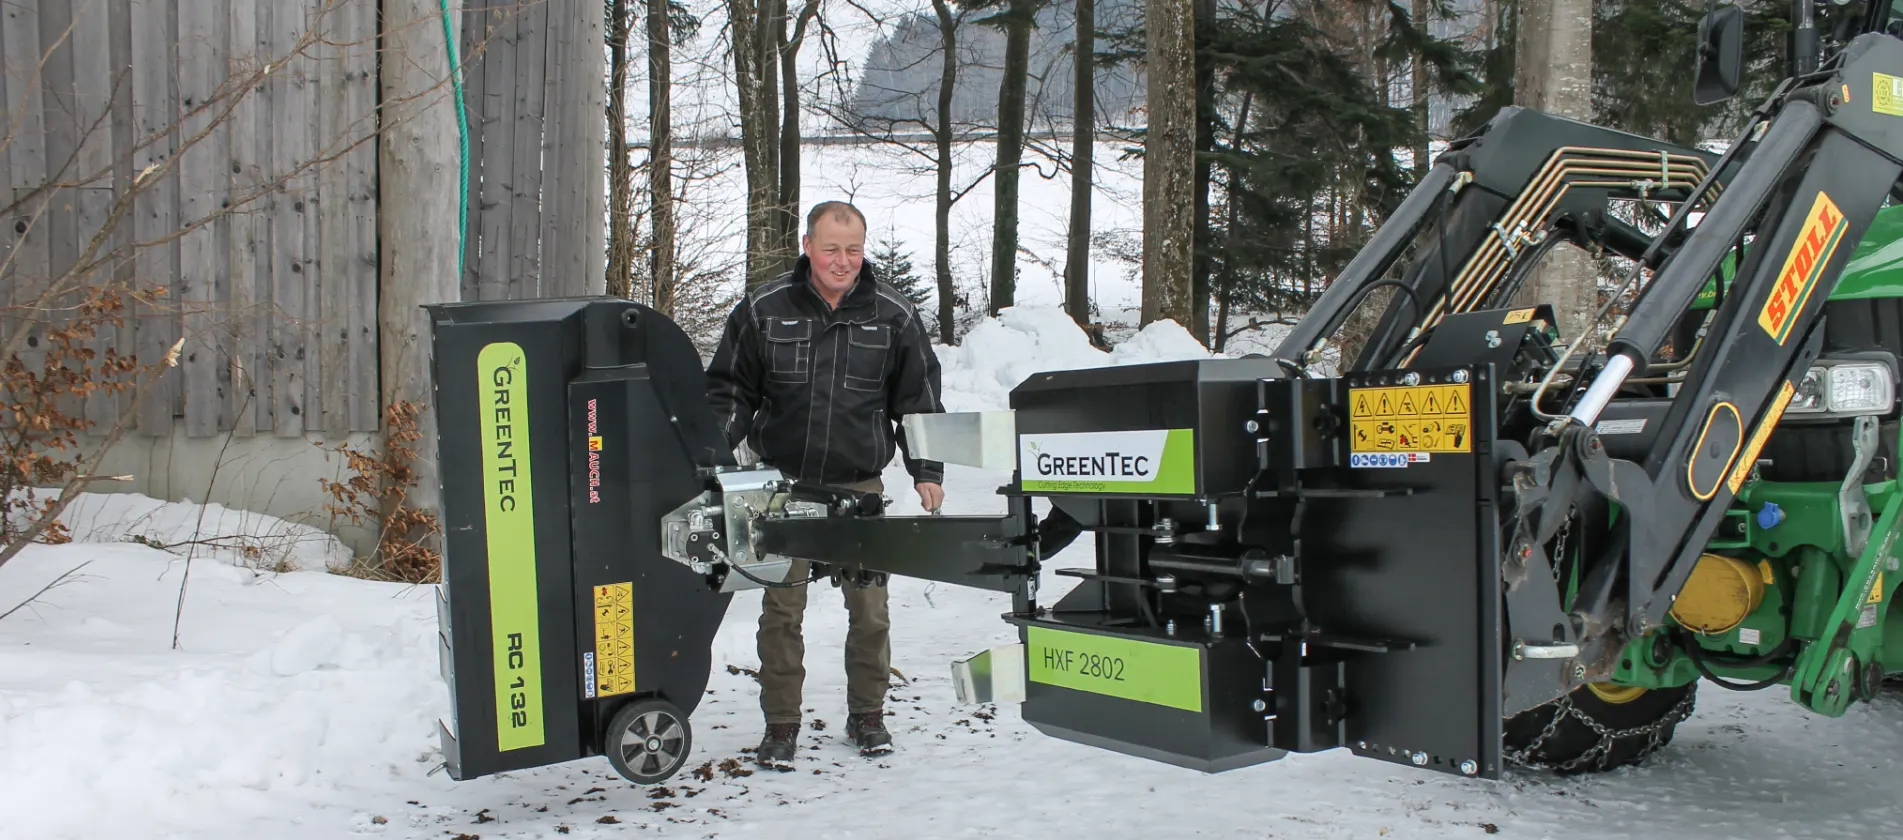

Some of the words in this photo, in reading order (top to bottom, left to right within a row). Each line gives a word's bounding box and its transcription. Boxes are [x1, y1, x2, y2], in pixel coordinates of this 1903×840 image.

[1767, 204, 1837, 332] STOLL
[493, 366, 517, 513] GREENTEC
[587, 398, 602, 504] www.MAUCH.at
[1037, 452, 1149, 476] GREENTEC
[1038, 480, 1057, 491] Cutting
[1058, 481, 1073, 491] Edge
[1073, 481, 1106, 492] Technology
[507, 632, 524, 670] RC
[1044, 647, 1074, 672] HXF
[1079, 652, 1125, 682] 2802
[510, 676, 527, 729] 132
